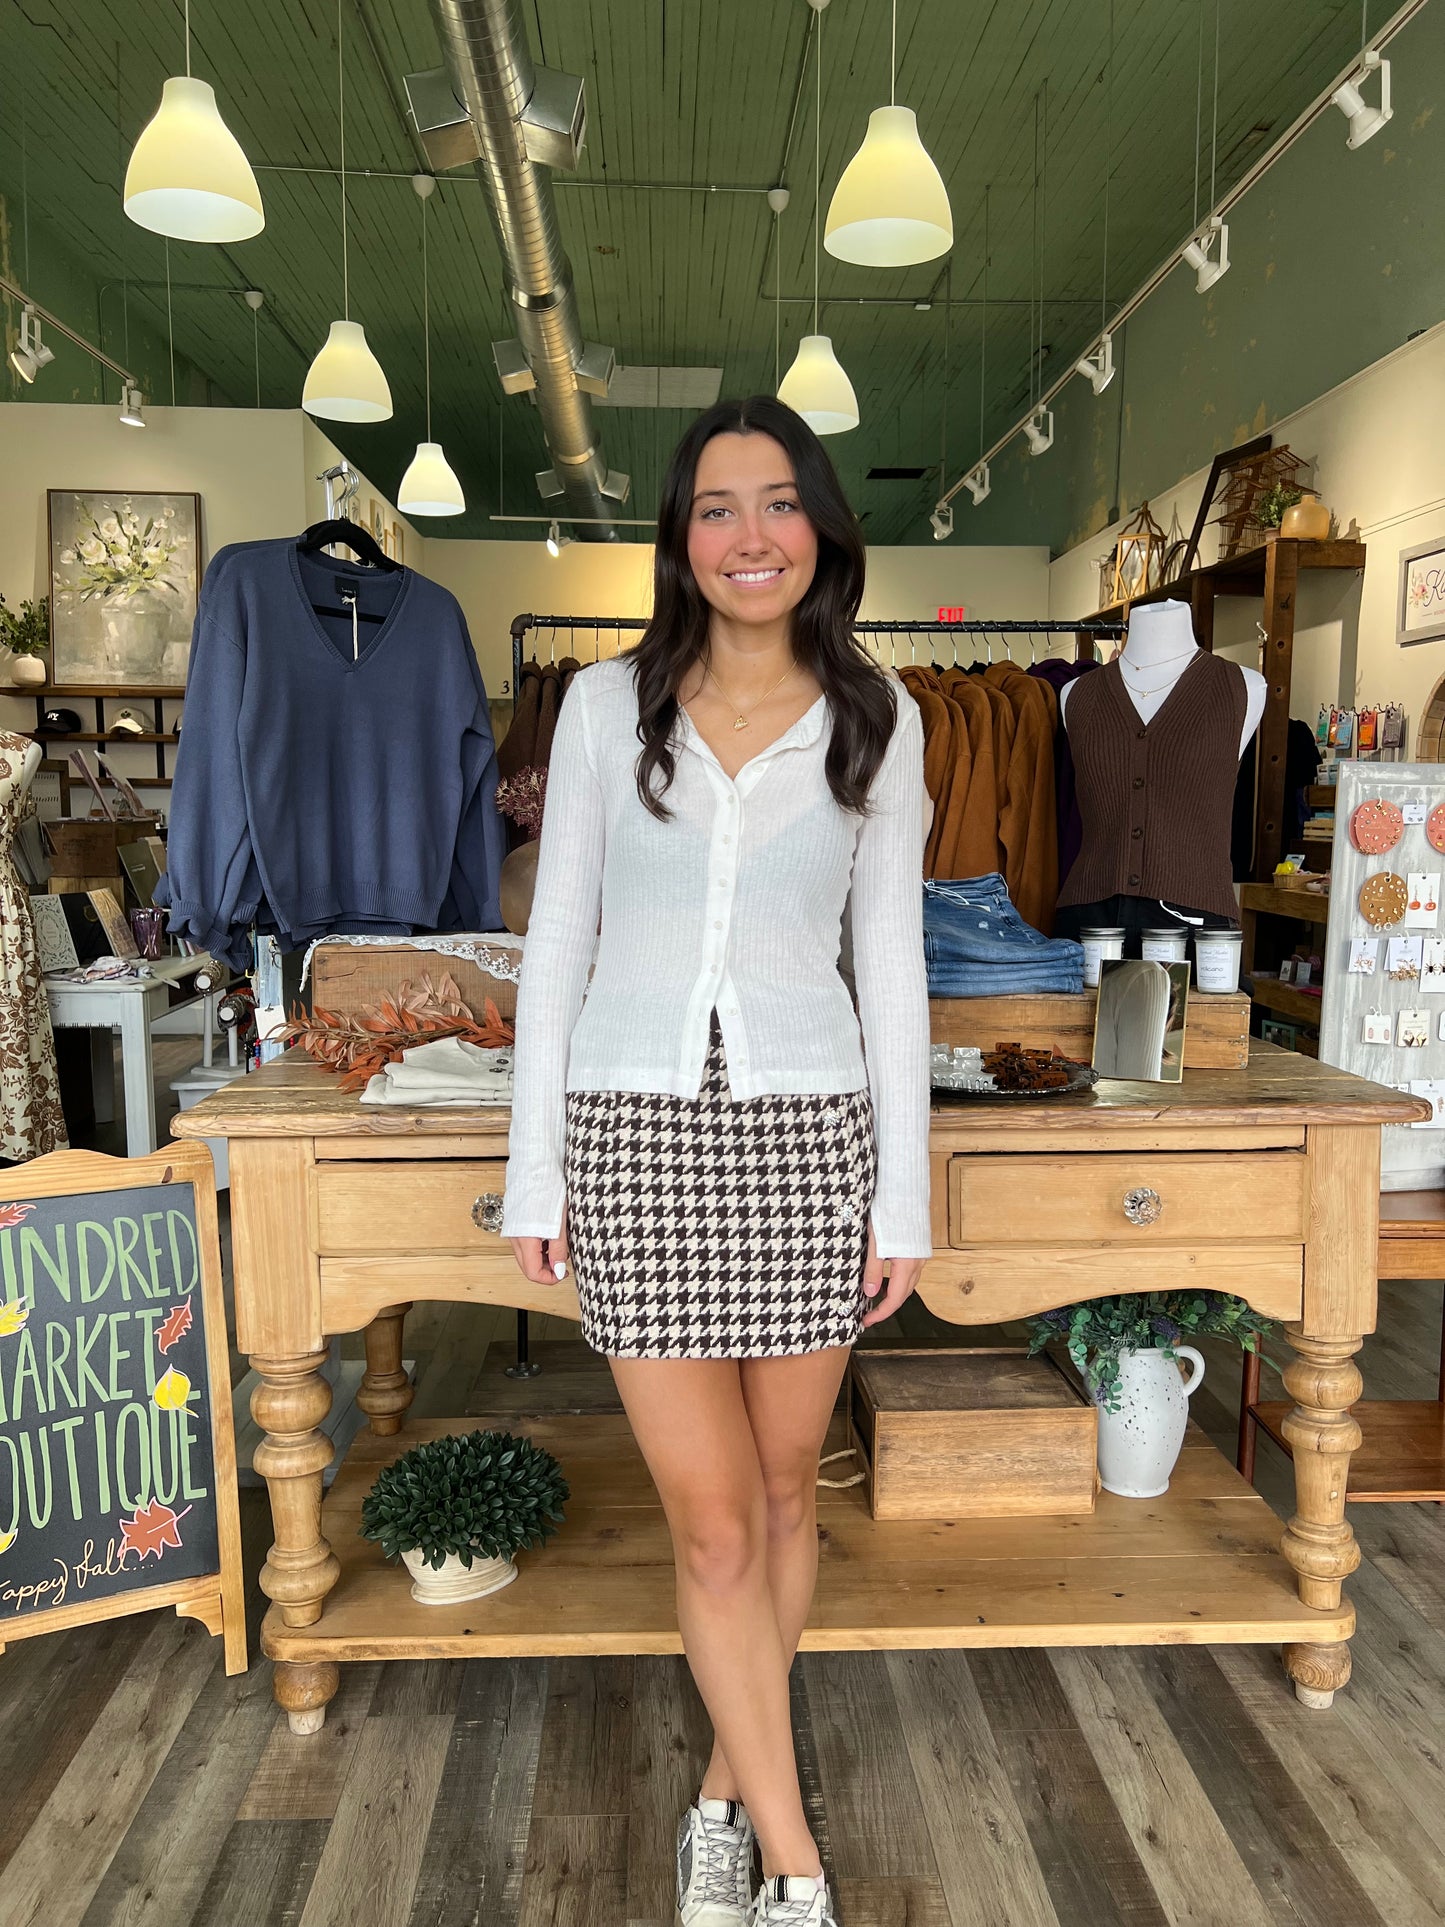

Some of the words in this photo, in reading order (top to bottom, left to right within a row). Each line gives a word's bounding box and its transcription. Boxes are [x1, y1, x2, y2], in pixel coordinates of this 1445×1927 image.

[938, 607, 965, 622] EXIT
[500, 680, 510, 694] 3
[0, 1307, 163, 1423] ARKET
[0, 1558, 69, 1611] appy
